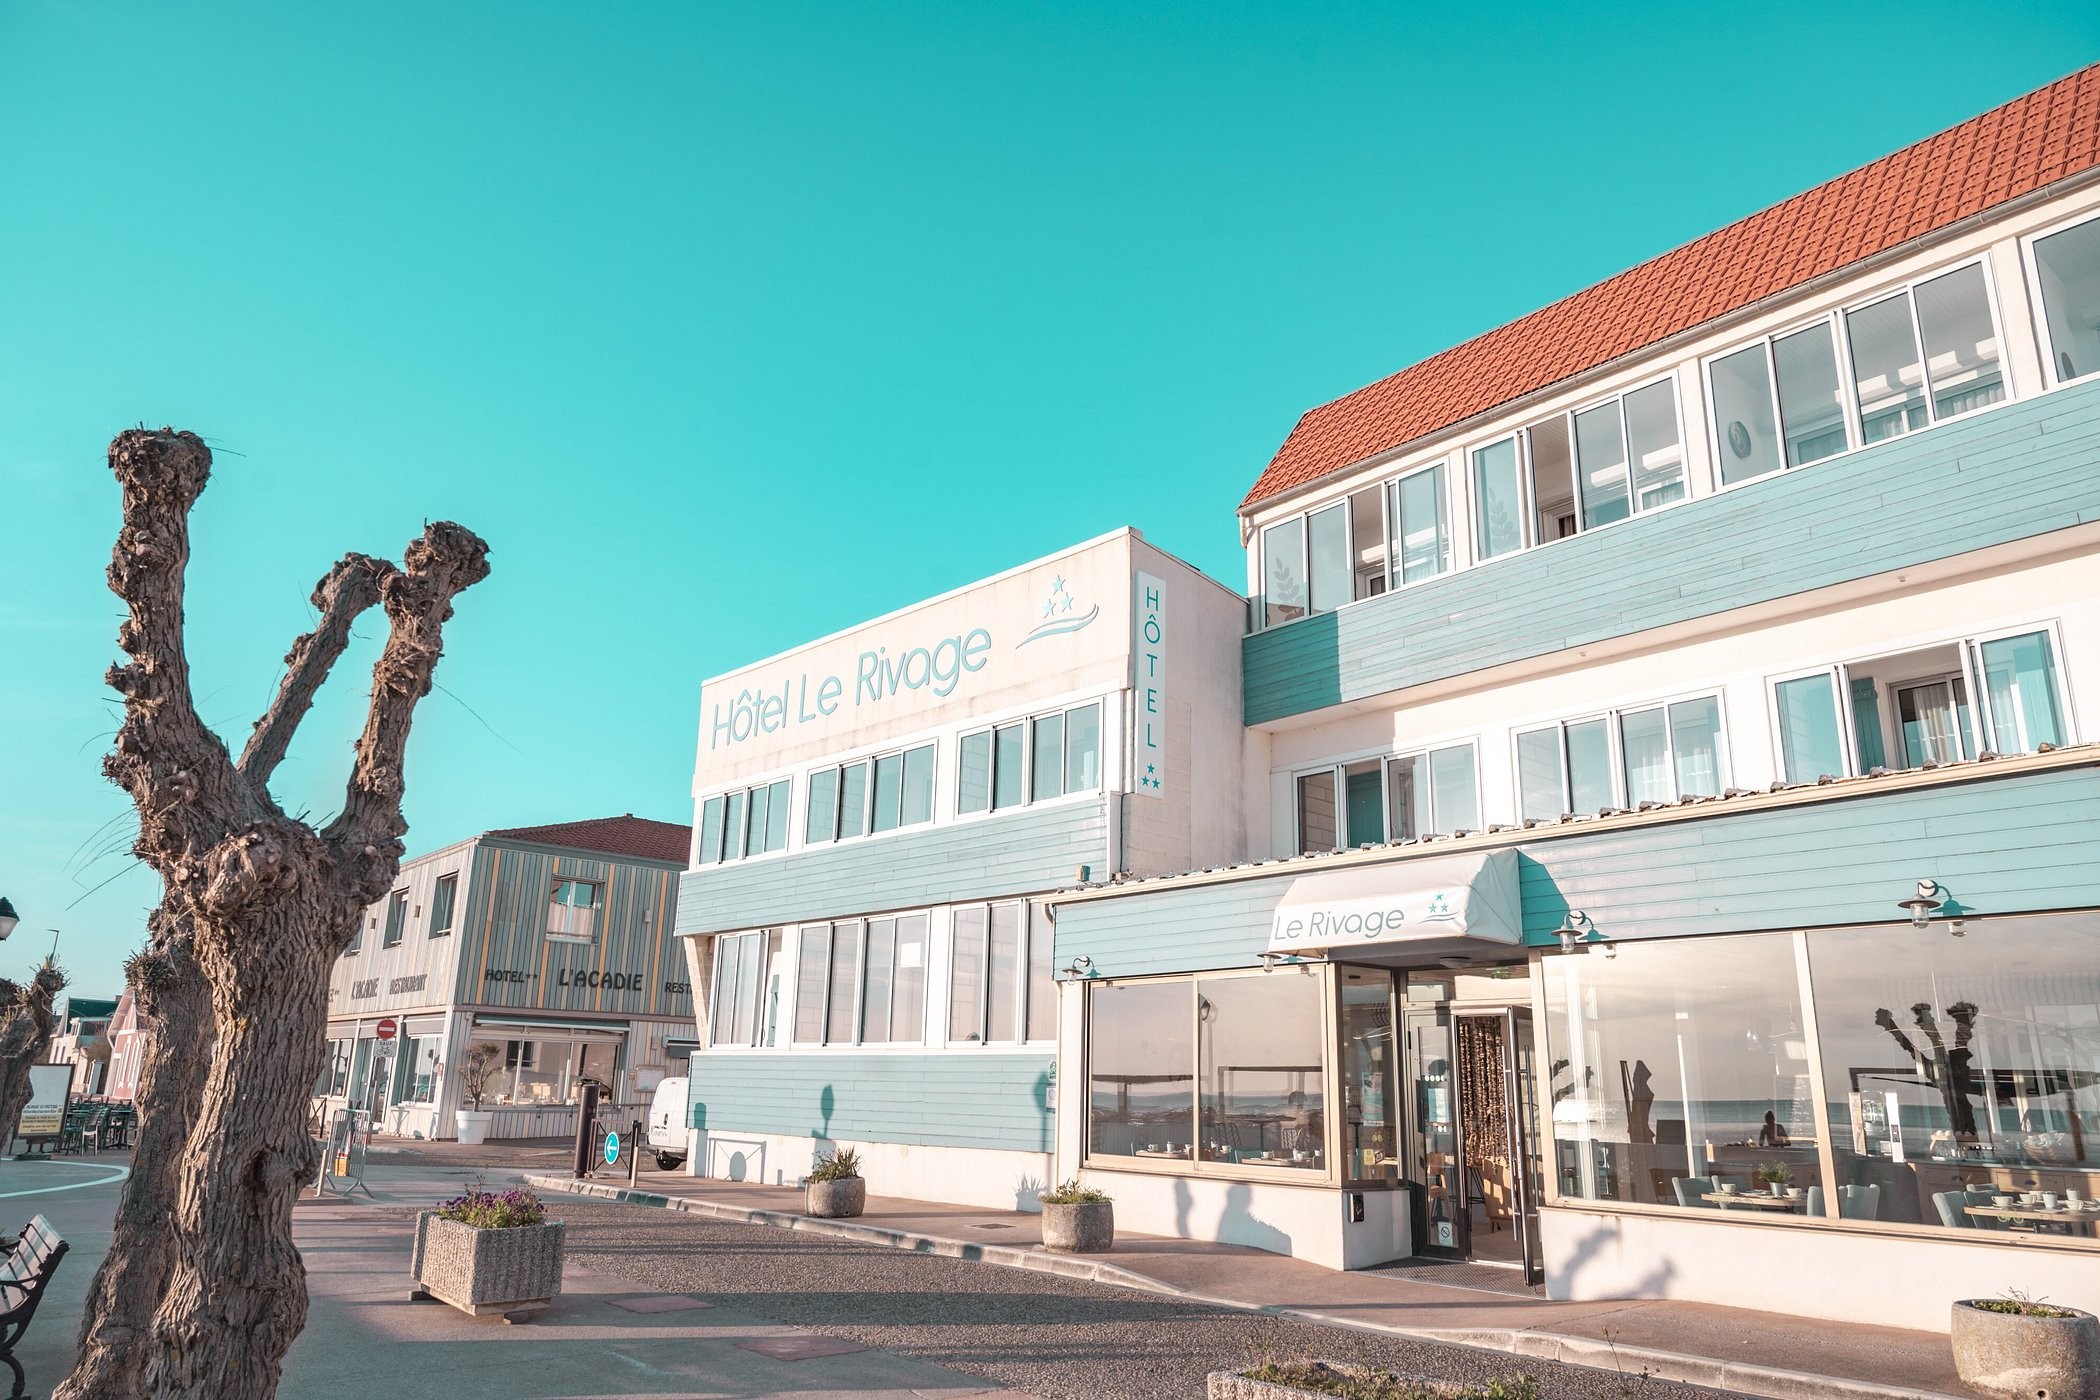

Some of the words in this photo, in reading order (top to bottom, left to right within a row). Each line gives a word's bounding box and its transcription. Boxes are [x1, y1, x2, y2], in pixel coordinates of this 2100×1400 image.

[1144, 586, 1161, 748] HÔTEL
[711, 679, 789, 750] Hôtel
[799, 673, 842, 723] Le
[856, 628, 992, 706] Rivage
[1274, 916, 1303, 940] Le
[1309, 909, 1405, 938] Rivage
[485, 969, 524, 983] HOTEL
[558, 968, 643, 991] L'ACADIE
